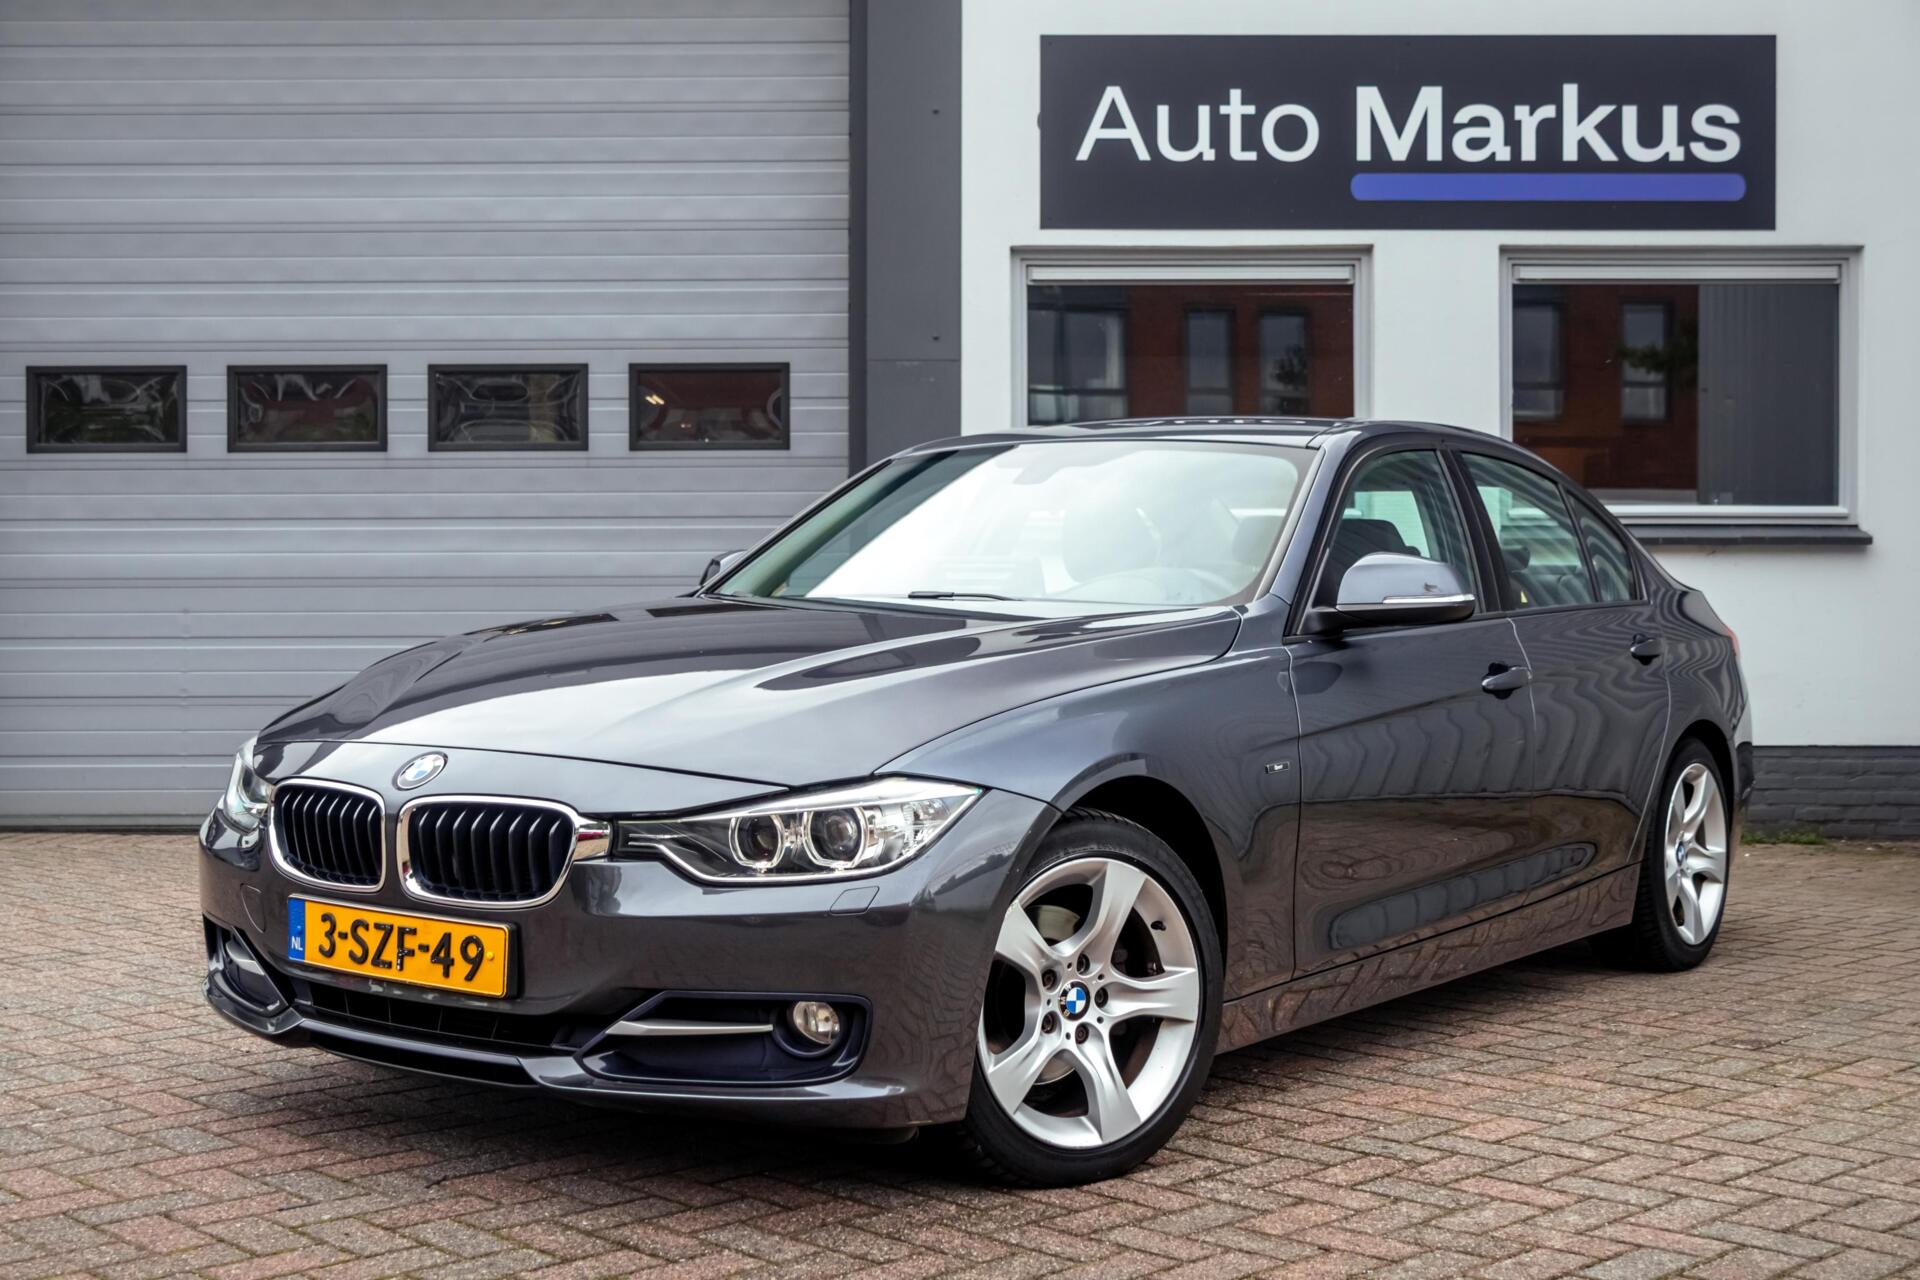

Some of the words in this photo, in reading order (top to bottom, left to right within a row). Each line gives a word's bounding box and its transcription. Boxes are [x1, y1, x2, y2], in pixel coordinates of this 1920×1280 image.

[1076, 85, 1320, 161] Auto
[1355, 83, 1742, 162] Markus
[291, 936, 303, 951] NL
[318, 912, 485, 982] 3-SZF-49
